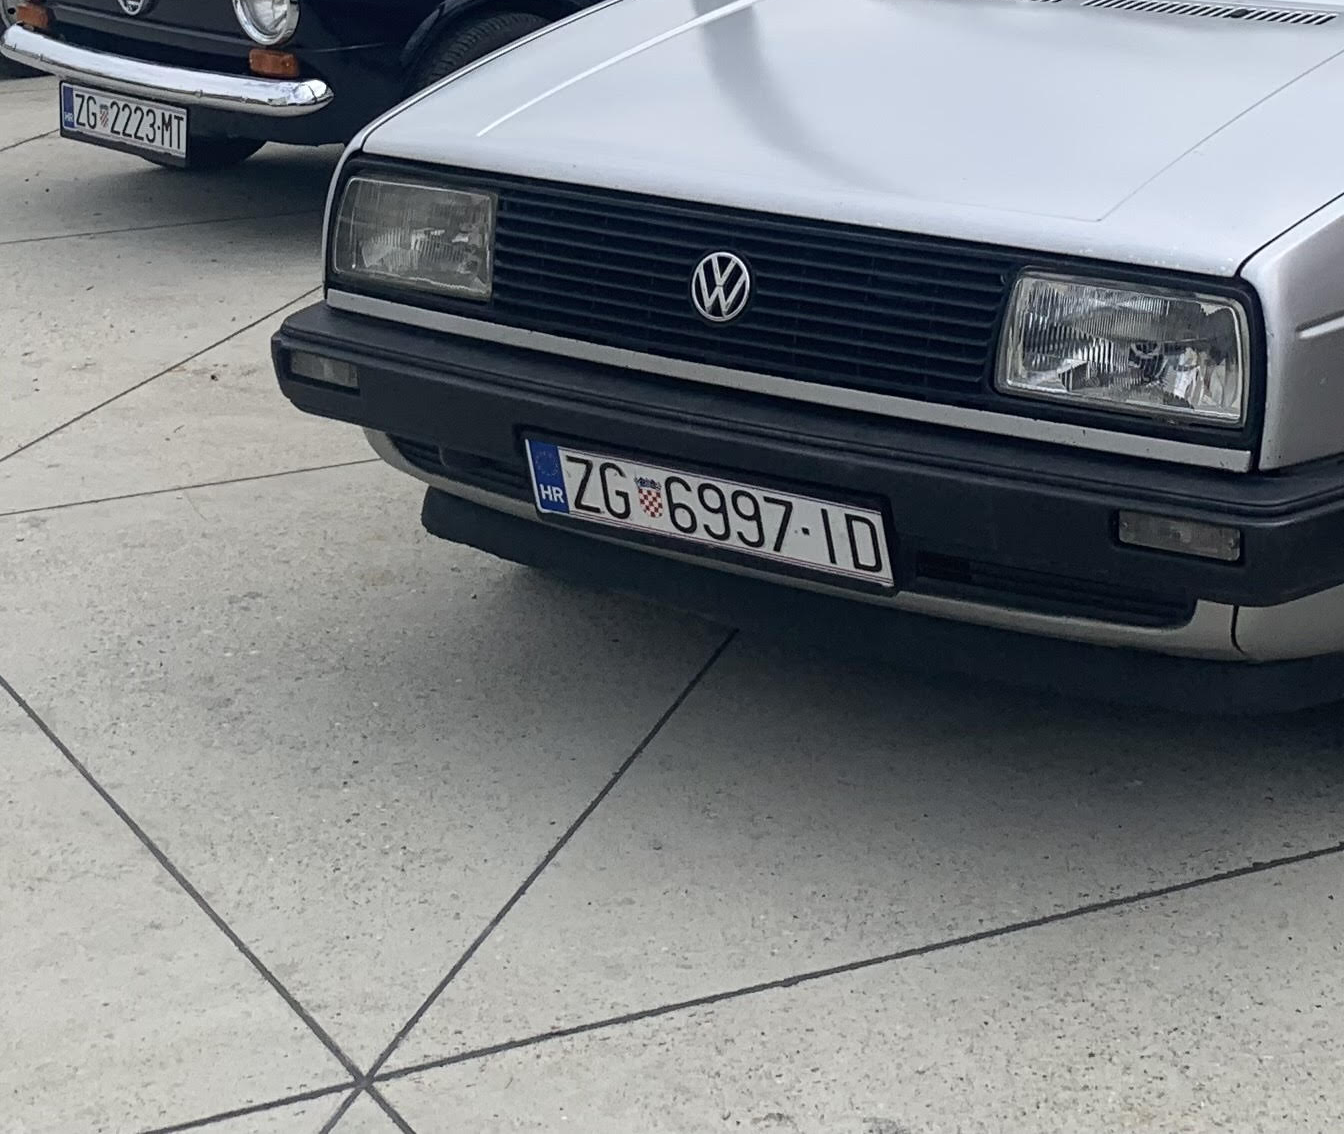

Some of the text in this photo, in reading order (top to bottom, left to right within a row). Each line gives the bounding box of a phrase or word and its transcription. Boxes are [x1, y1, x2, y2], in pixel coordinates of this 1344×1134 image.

[75, 93, 97, 129] ZG
[539, 483, 565, 504] HR
[566, 454, 632, 519] ZG
